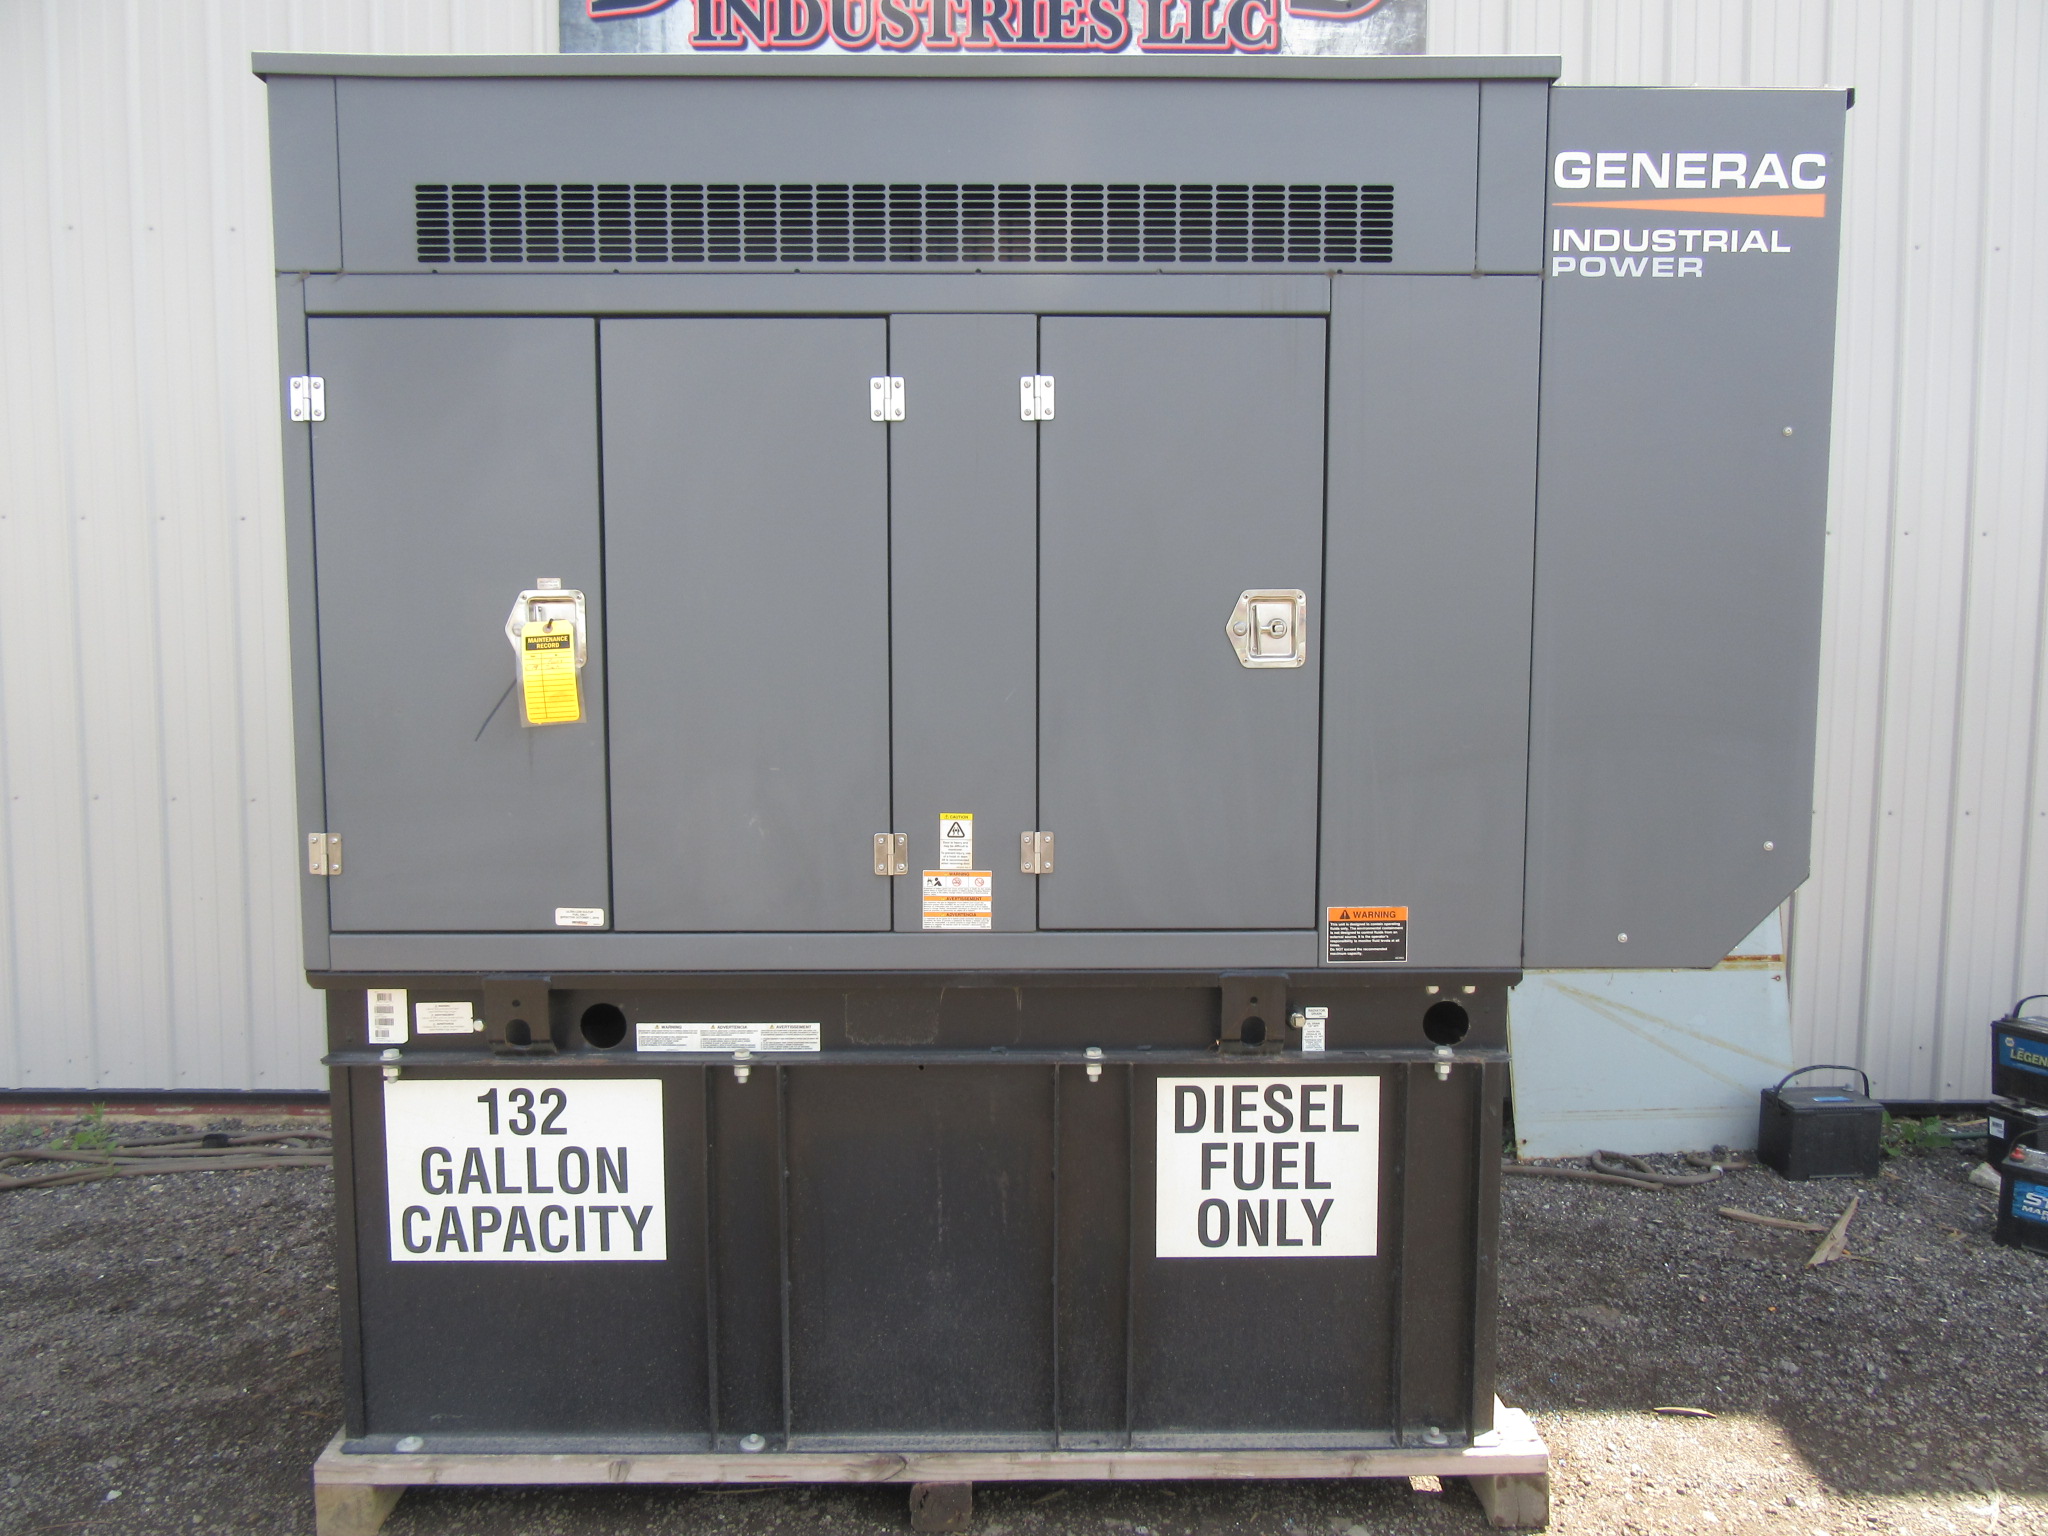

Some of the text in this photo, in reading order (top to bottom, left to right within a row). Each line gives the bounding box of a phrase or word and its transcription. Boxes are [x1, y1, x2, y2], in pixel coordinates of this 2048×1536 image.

[690, 0, 1280, 51] INDUSTRIES LLC
[1554, 152, 1826, 190] GENERAC
[1552, 229, 1791, 253] INDUSTRIAL
[1552, 256, 1703, 278] POWER
[528, 635, 568, 644] MAINTENANCE
[2010, 1048, 2048, 1068] LEGEN
[478, 1088, 568, 1135] 132
[1174, 1084, 1359, 1134] DIESEL
[421, 1146, 628, 1195] GALLON
[1201, 1142, 1332, 1190] FUEL
[402, 1204, 653, 1253] CAPACITY
[1198, 1198, 1334, 1248] ONLY
